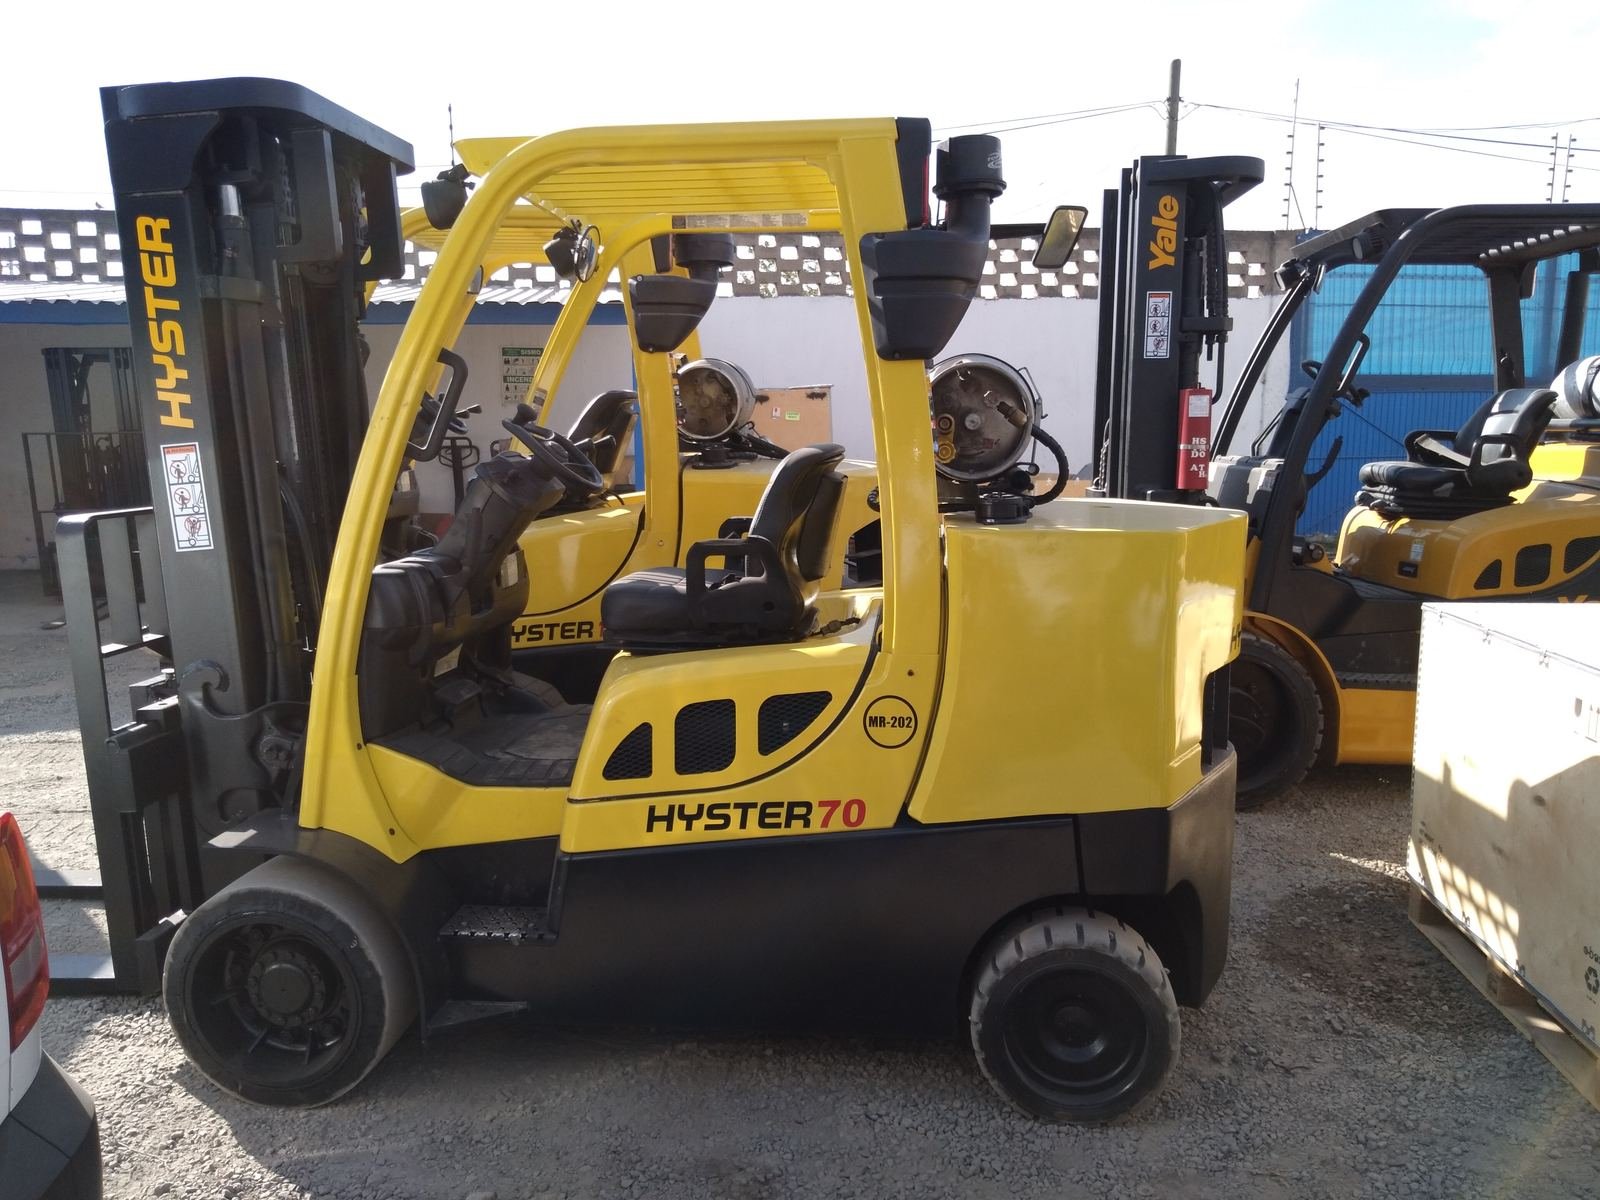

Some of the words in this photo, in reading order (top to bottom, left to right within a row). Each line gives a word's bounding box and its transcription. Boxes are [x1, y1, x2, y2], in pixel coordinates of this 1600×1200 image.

[1149, 195, 1179, 270] Yale
[136, 216, 194, 429] HYSTER
[511, 621, 595, 643] YSTER
[868, 715, 913, 729] MR-202
[646, 801, 813, 832] HYSTER
[817, 799, 867, 829] 70
